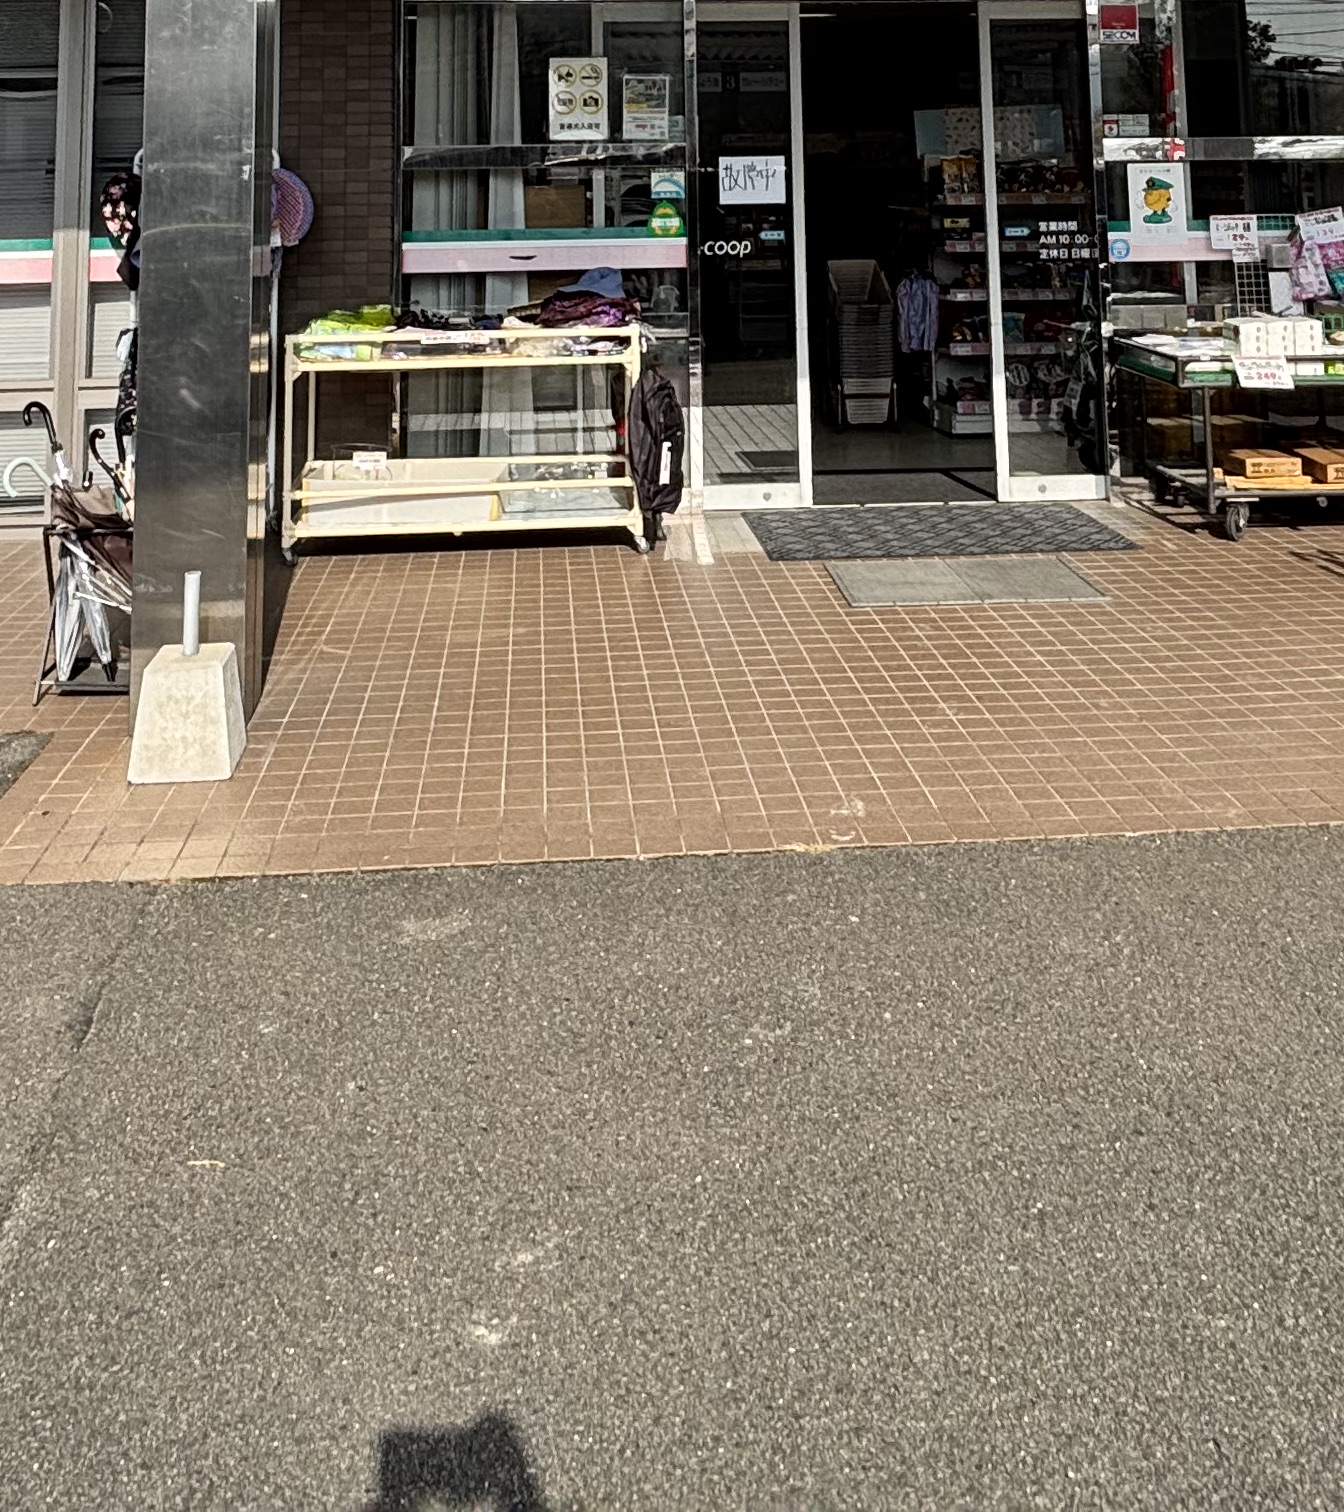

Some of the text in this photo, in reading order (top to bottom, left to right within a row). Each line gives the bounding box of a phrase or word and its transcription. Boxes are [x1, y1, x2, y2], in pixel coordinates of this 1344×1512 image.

[1102, 31, 1136, 40] SECOM
[1038, 221, 1078, 232] 営業時間
[1039, 234, 1057, 244] AM
[1039, 248, 1068, 259] 定休日
